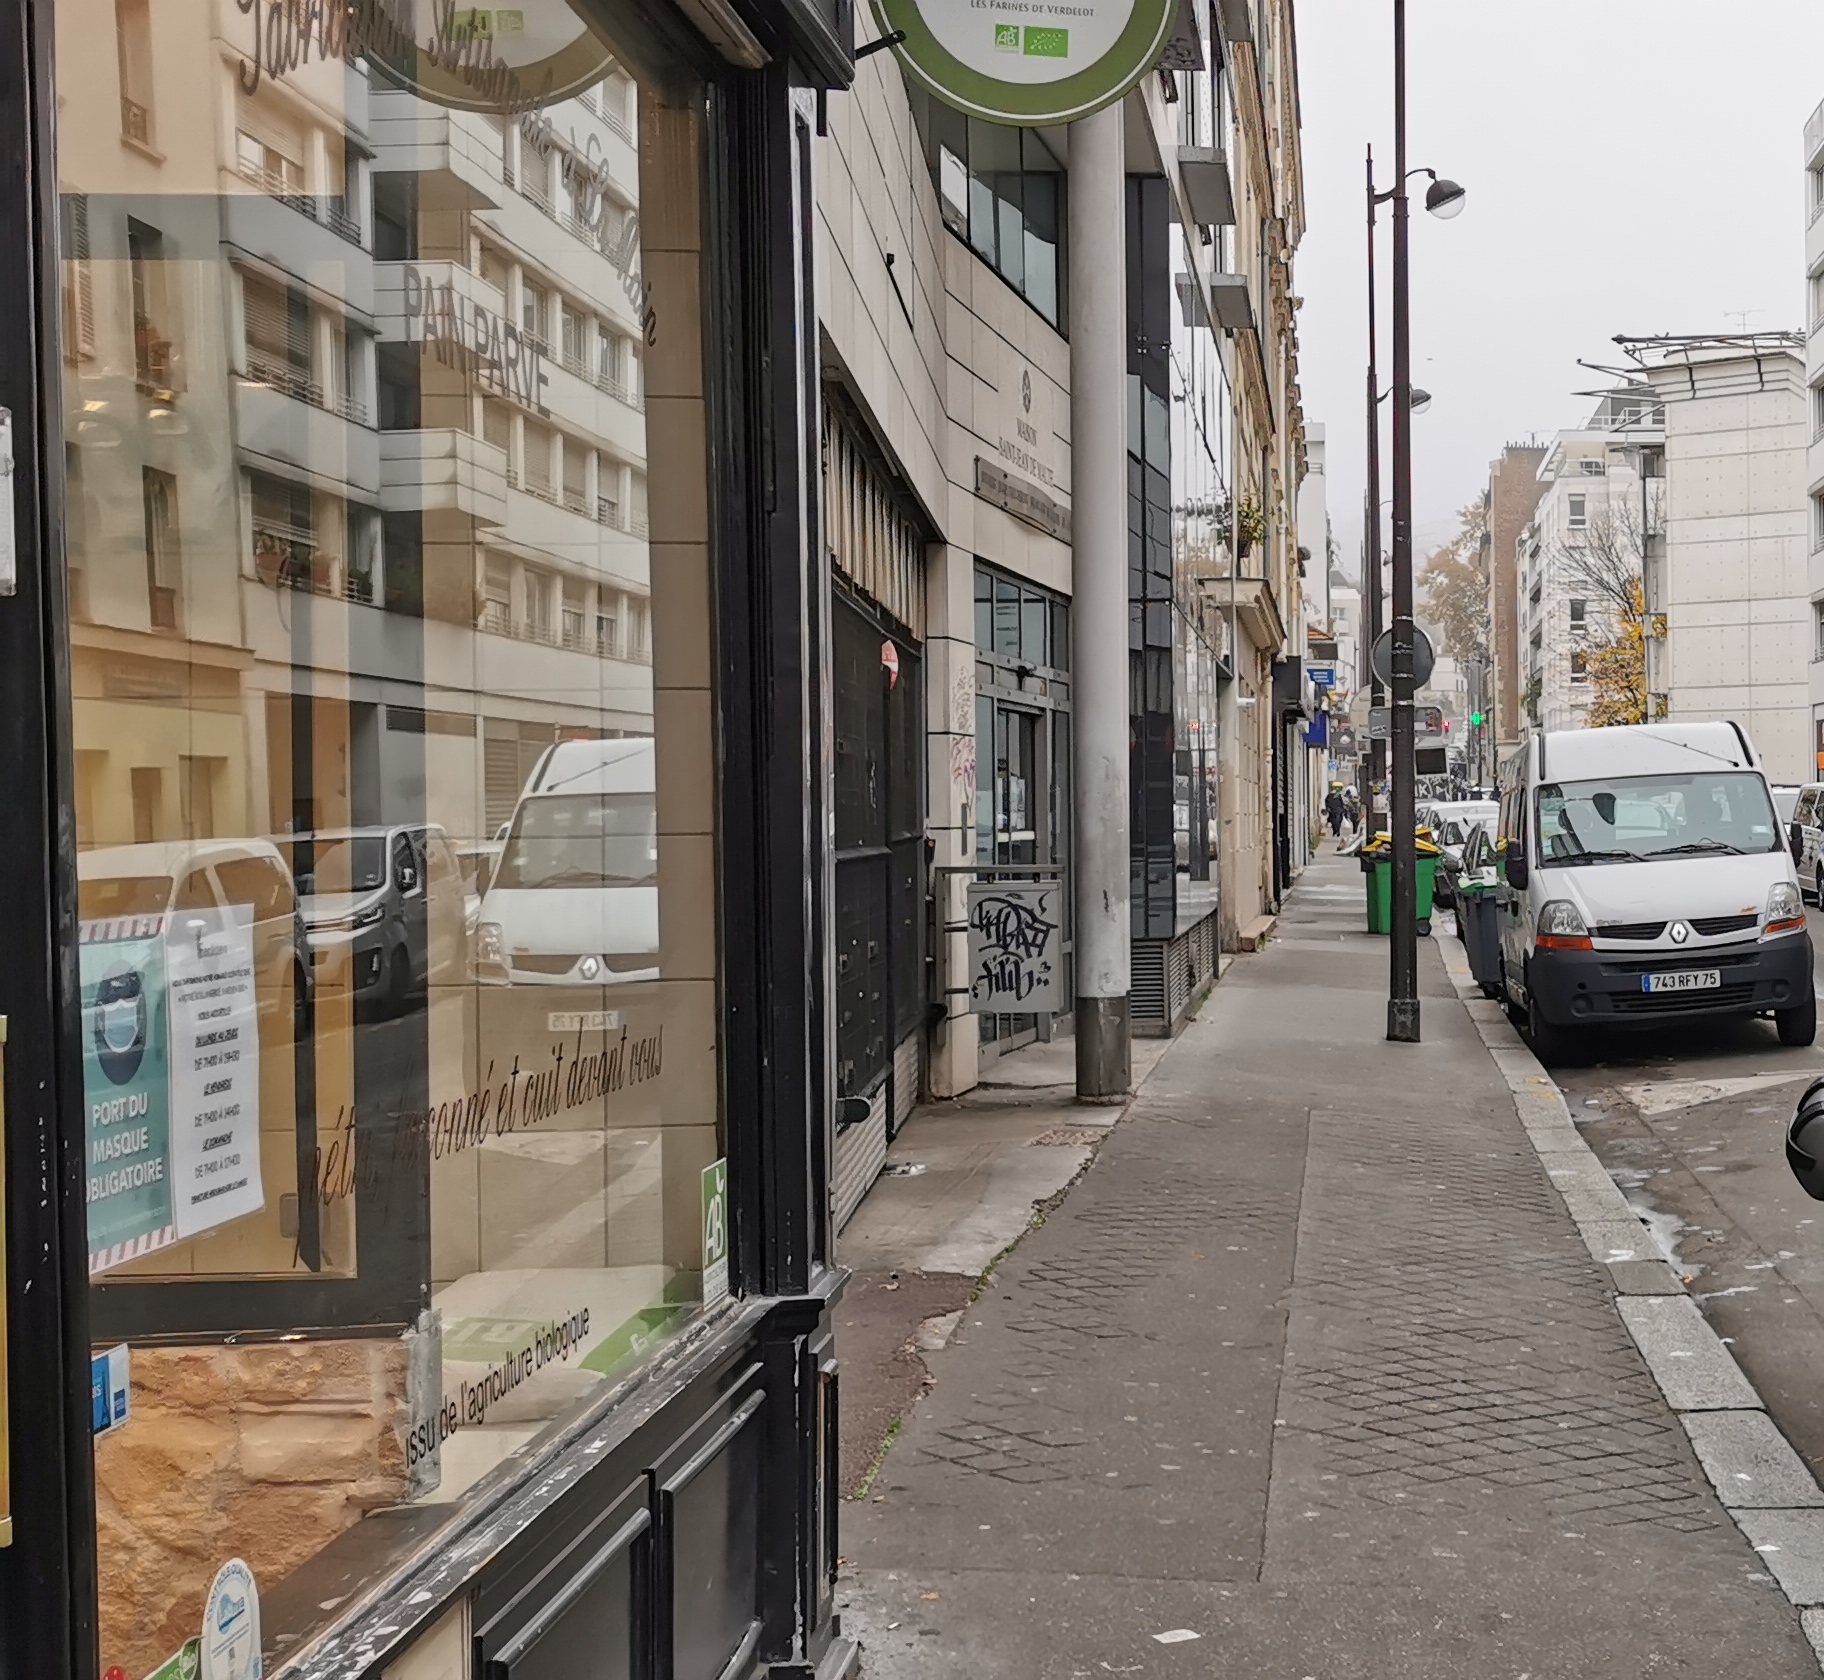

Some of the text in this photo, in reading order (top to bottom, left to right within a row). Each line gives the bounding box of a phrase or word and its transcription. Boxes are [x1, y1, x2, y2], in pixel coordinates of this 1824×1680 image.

[990, 0, 1029, 13] FARINES
[1032, 5, 1044, 13] DE
[1047, 5, 1094, 16] VERDELOT
[404, 264, 551, 420] PAIN PARVE
[1654, 973, 1717, 989] 743 RFY 75
[496, 1054, 519, 1138] et
[522, 1042, 564, 1127] cuit
[565, 1016, 628, 1109] devant
[629, 1024, 663, 1087] vous
[92, 1091, 149, 1129] PORT DU
[92, 1126, 149, 1166] MASQUE
[705, 1193, 724, 1268] AB
[405, 1415, 436, 1469] issu
[439, 1394, 458, 1442] de
[460, 1346, 534, 1427] l'agriculture
[535, 1306, 590, 1371] biologique
